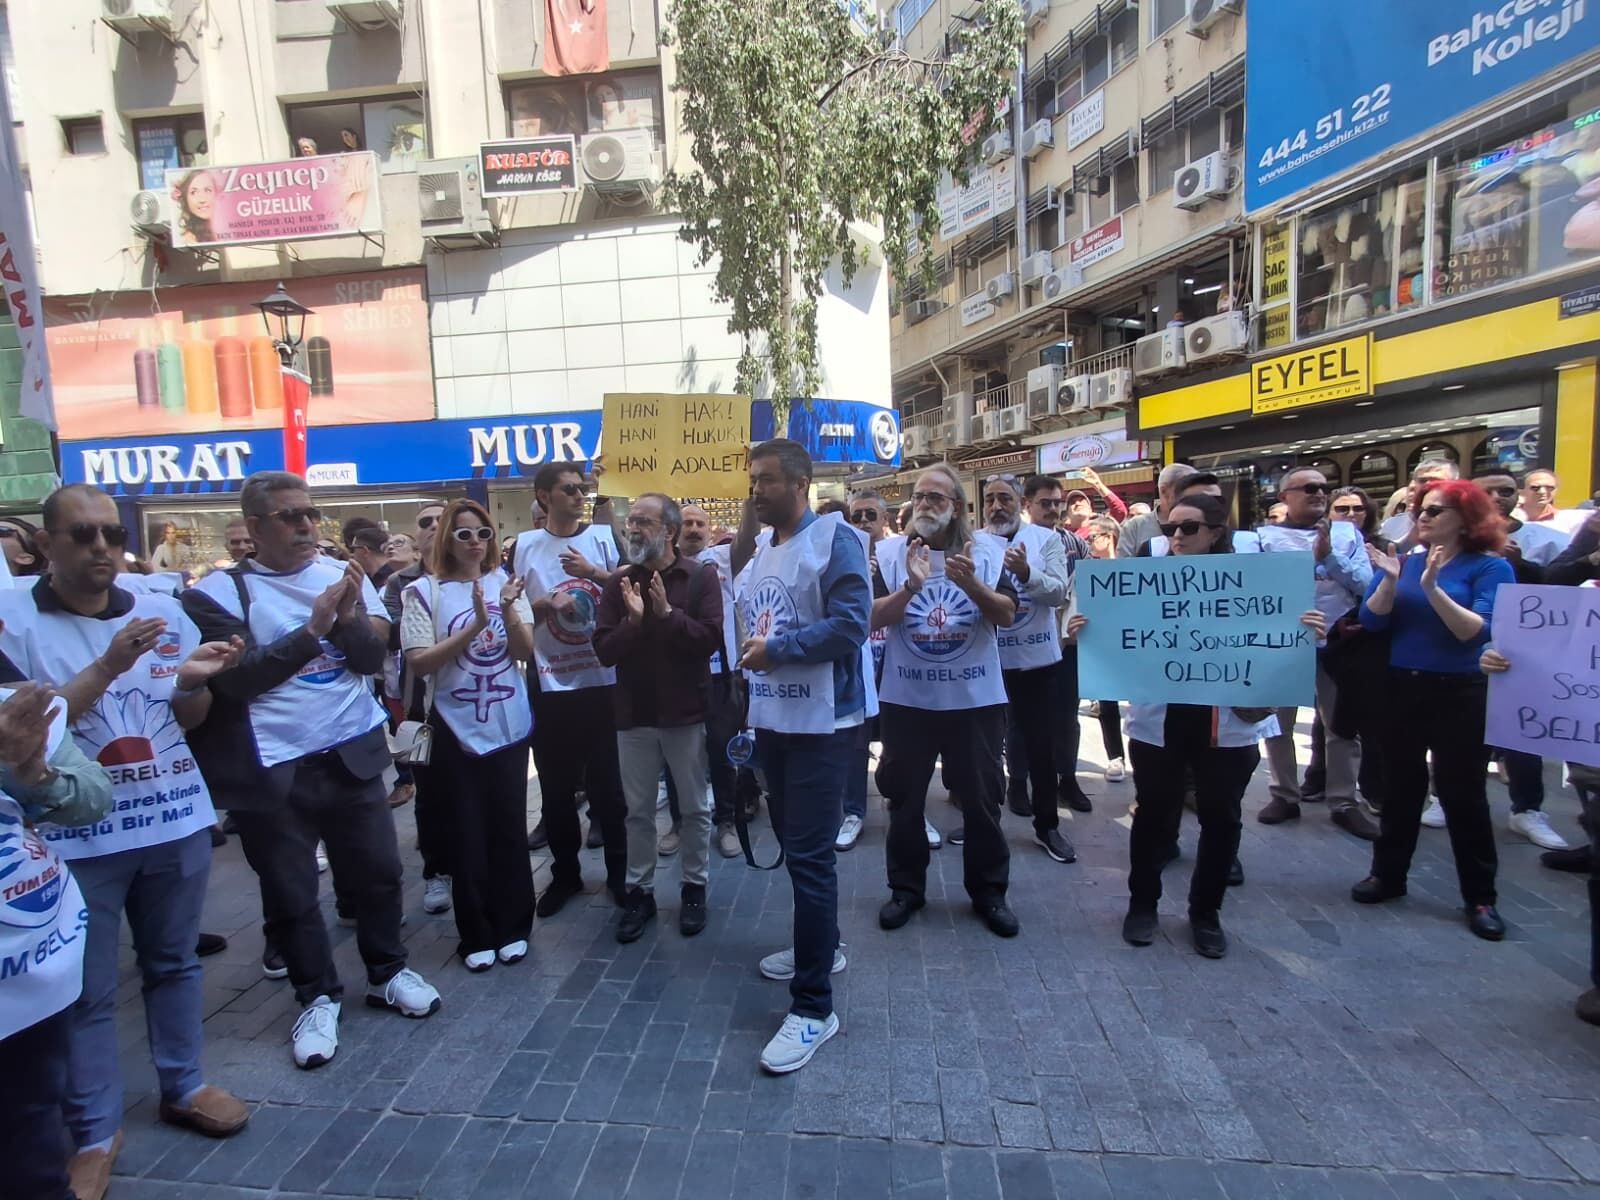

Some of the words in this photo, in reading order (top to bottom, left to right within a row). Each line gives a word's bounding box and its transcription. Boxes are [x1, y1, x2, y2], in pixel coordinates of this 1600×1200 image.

[1427, 0, 1552, 67] Bahçe
[1473, 0, 1585, 76] Koleji
[1258, 129, 1308, 168] 444
[1315, 109, 1342, 140] 51
[1352, 83, 1391, 122] 22
[485, 148, 570, 170] KUAFÖR
[1258, 111, 1389, 184] www.bahcesehir.k12.tr
[222, 165, 329, 194] Zeynep
[236, 193, 313, 217] GÜZELLİK
[335, 277, 419, 304] SPECIAL
[343, 304, 411, 331] SERIES
[1258, 347, 1359, 394] EYFEL
[1257, 402, 1278, 410] EAU
[1310, 386, 1360, 400] PARFUM
[820, 423, 855, 437] ALTIN
[468, 422, 602, 467] MUR
[81, 441, 251, 485] MURAT
[670, 450, 748, 476] ADALET!
[1090, 565, 1242, 597] MEMURUN
[1162, 600, 1190, 619] EK
[1200, 595, 1283, 618] HESABI
[1519, 595, 1568, 629] BU
[998, 632, 1051, 647] BEL-SEN
[927, 665, 985, 681] BEL-SEN
[1164, 660, 1252, 686] OLDU!
[756, 684, 811, 698] BEL-SEN
[110, 764, 167, 785] EREL-
[112, 783, 201, 812] arektinde
[121, 814, 155, 831] Bir
[35, 908, 88, 966] BEL-S
